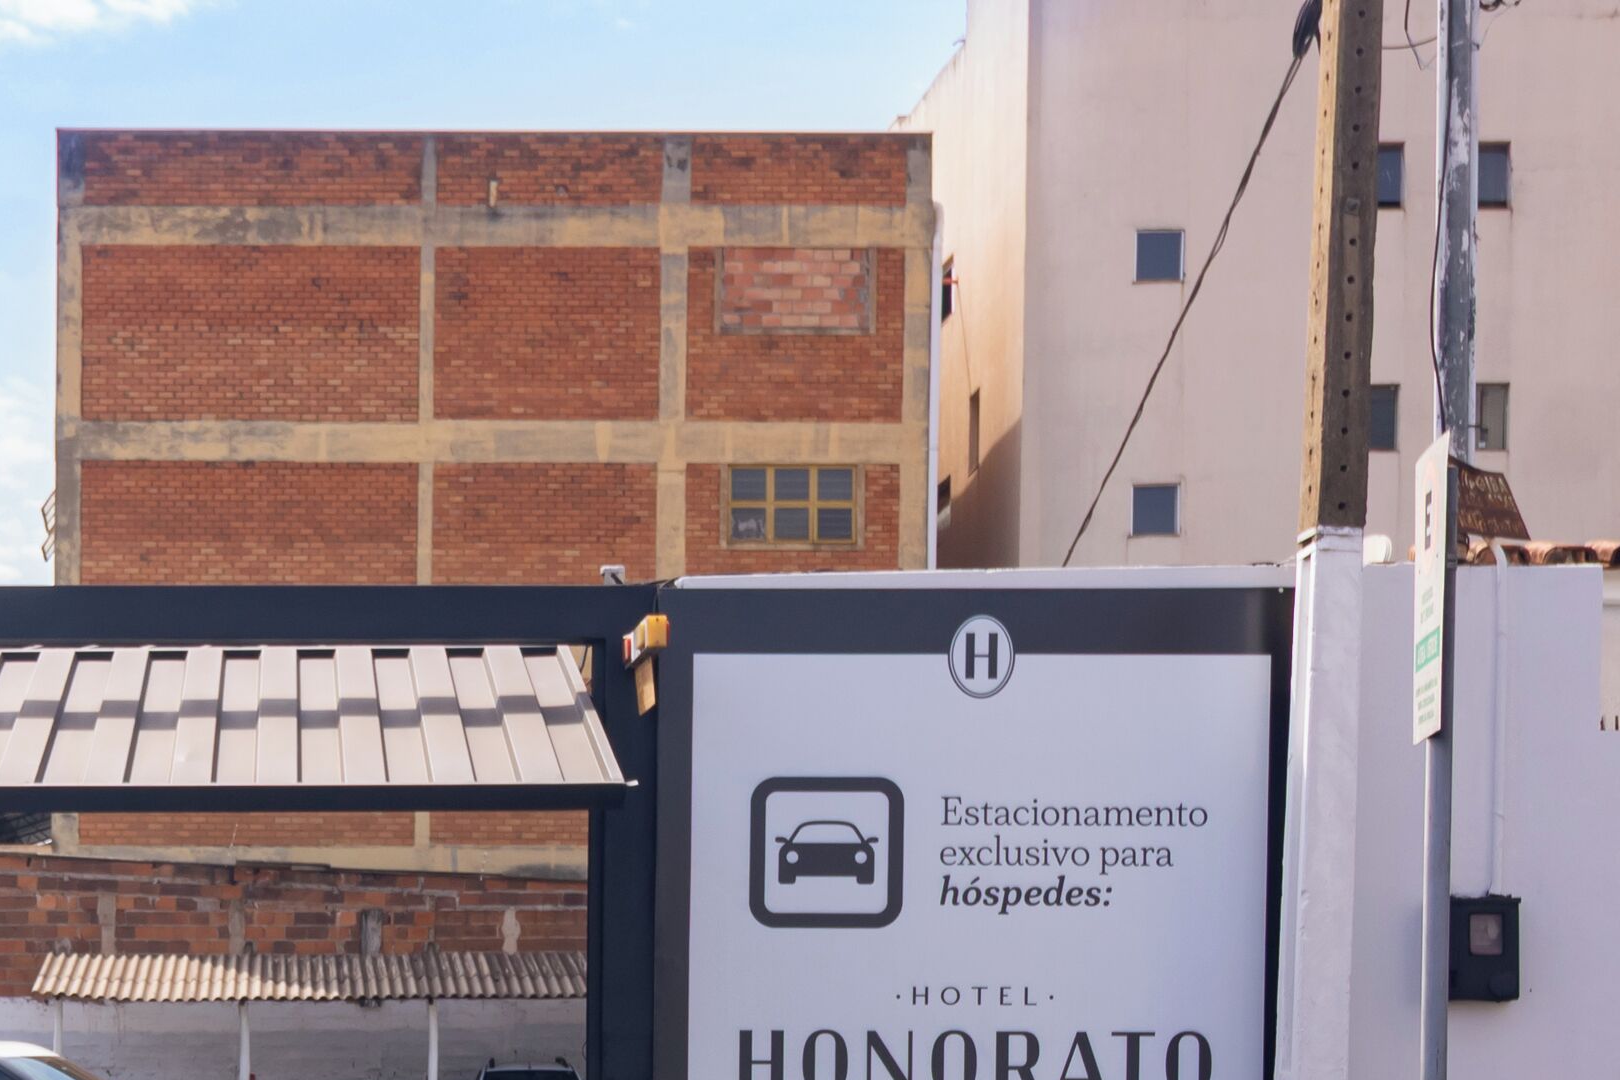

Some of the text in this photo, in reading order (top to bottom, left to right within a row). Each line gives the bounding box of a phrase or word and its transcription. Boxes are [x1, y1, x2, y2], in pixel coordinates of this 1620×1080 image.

[1424, 490, 1432, 550] E
[965, 632, 999, 680] H
[940, 796, 1209, 828] Estacionamento
[939, 835, 1174, 876] exclusivo para
[939, 875, 1113, 915] hóspedes:
